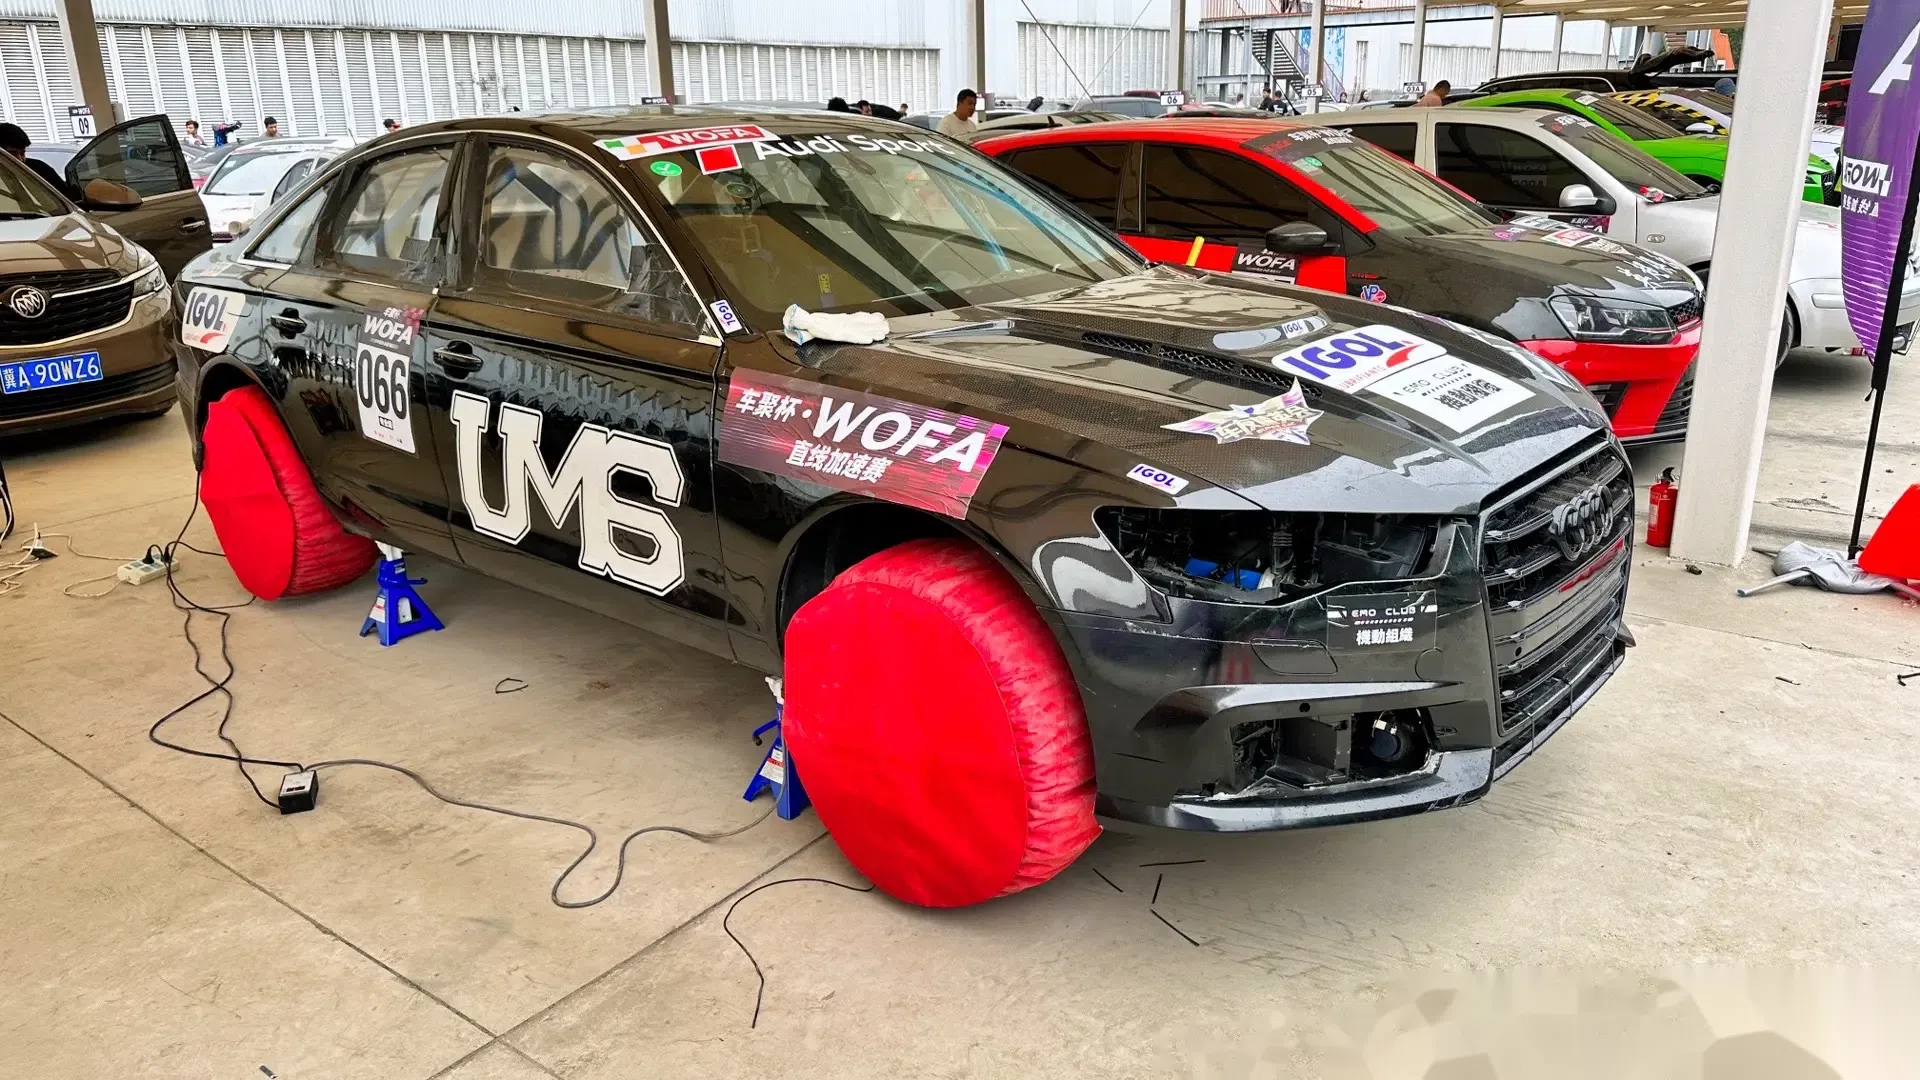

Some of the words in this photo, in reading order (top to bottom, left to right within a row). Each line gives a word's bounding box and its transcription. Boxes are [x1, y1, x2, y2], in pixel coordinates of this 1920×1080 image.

[1167, 96, 1178, 105] 06
[78, 117, 90, 134] 09
[659, 126, 758, 143] WOFA
[757, 135, 848, 161] Audi
[848, 134, 955, 155] Sport
[1238, 253, 1296, 271] WOFA
[186, 292, 228, 331] IGOL
[716, 301, 736, 326] IGOL
[364, 315, 413, 346] WOFA
[1284, 321, 1303, 334] IGOL
[1281, 332, 1405, 380] IGOL
[358, 350, 407, 420] 066
[813, 397, 987, 472] WOFA
[786, 439, 892, 484] 直线加速赛
[1134, 466, 1176, 487] IGOL
[1351, 609, 1377, 618] EMO
[1385, 606, 1416, 616] CLUB
[1356, 627, 1413, 646] 機動組織
